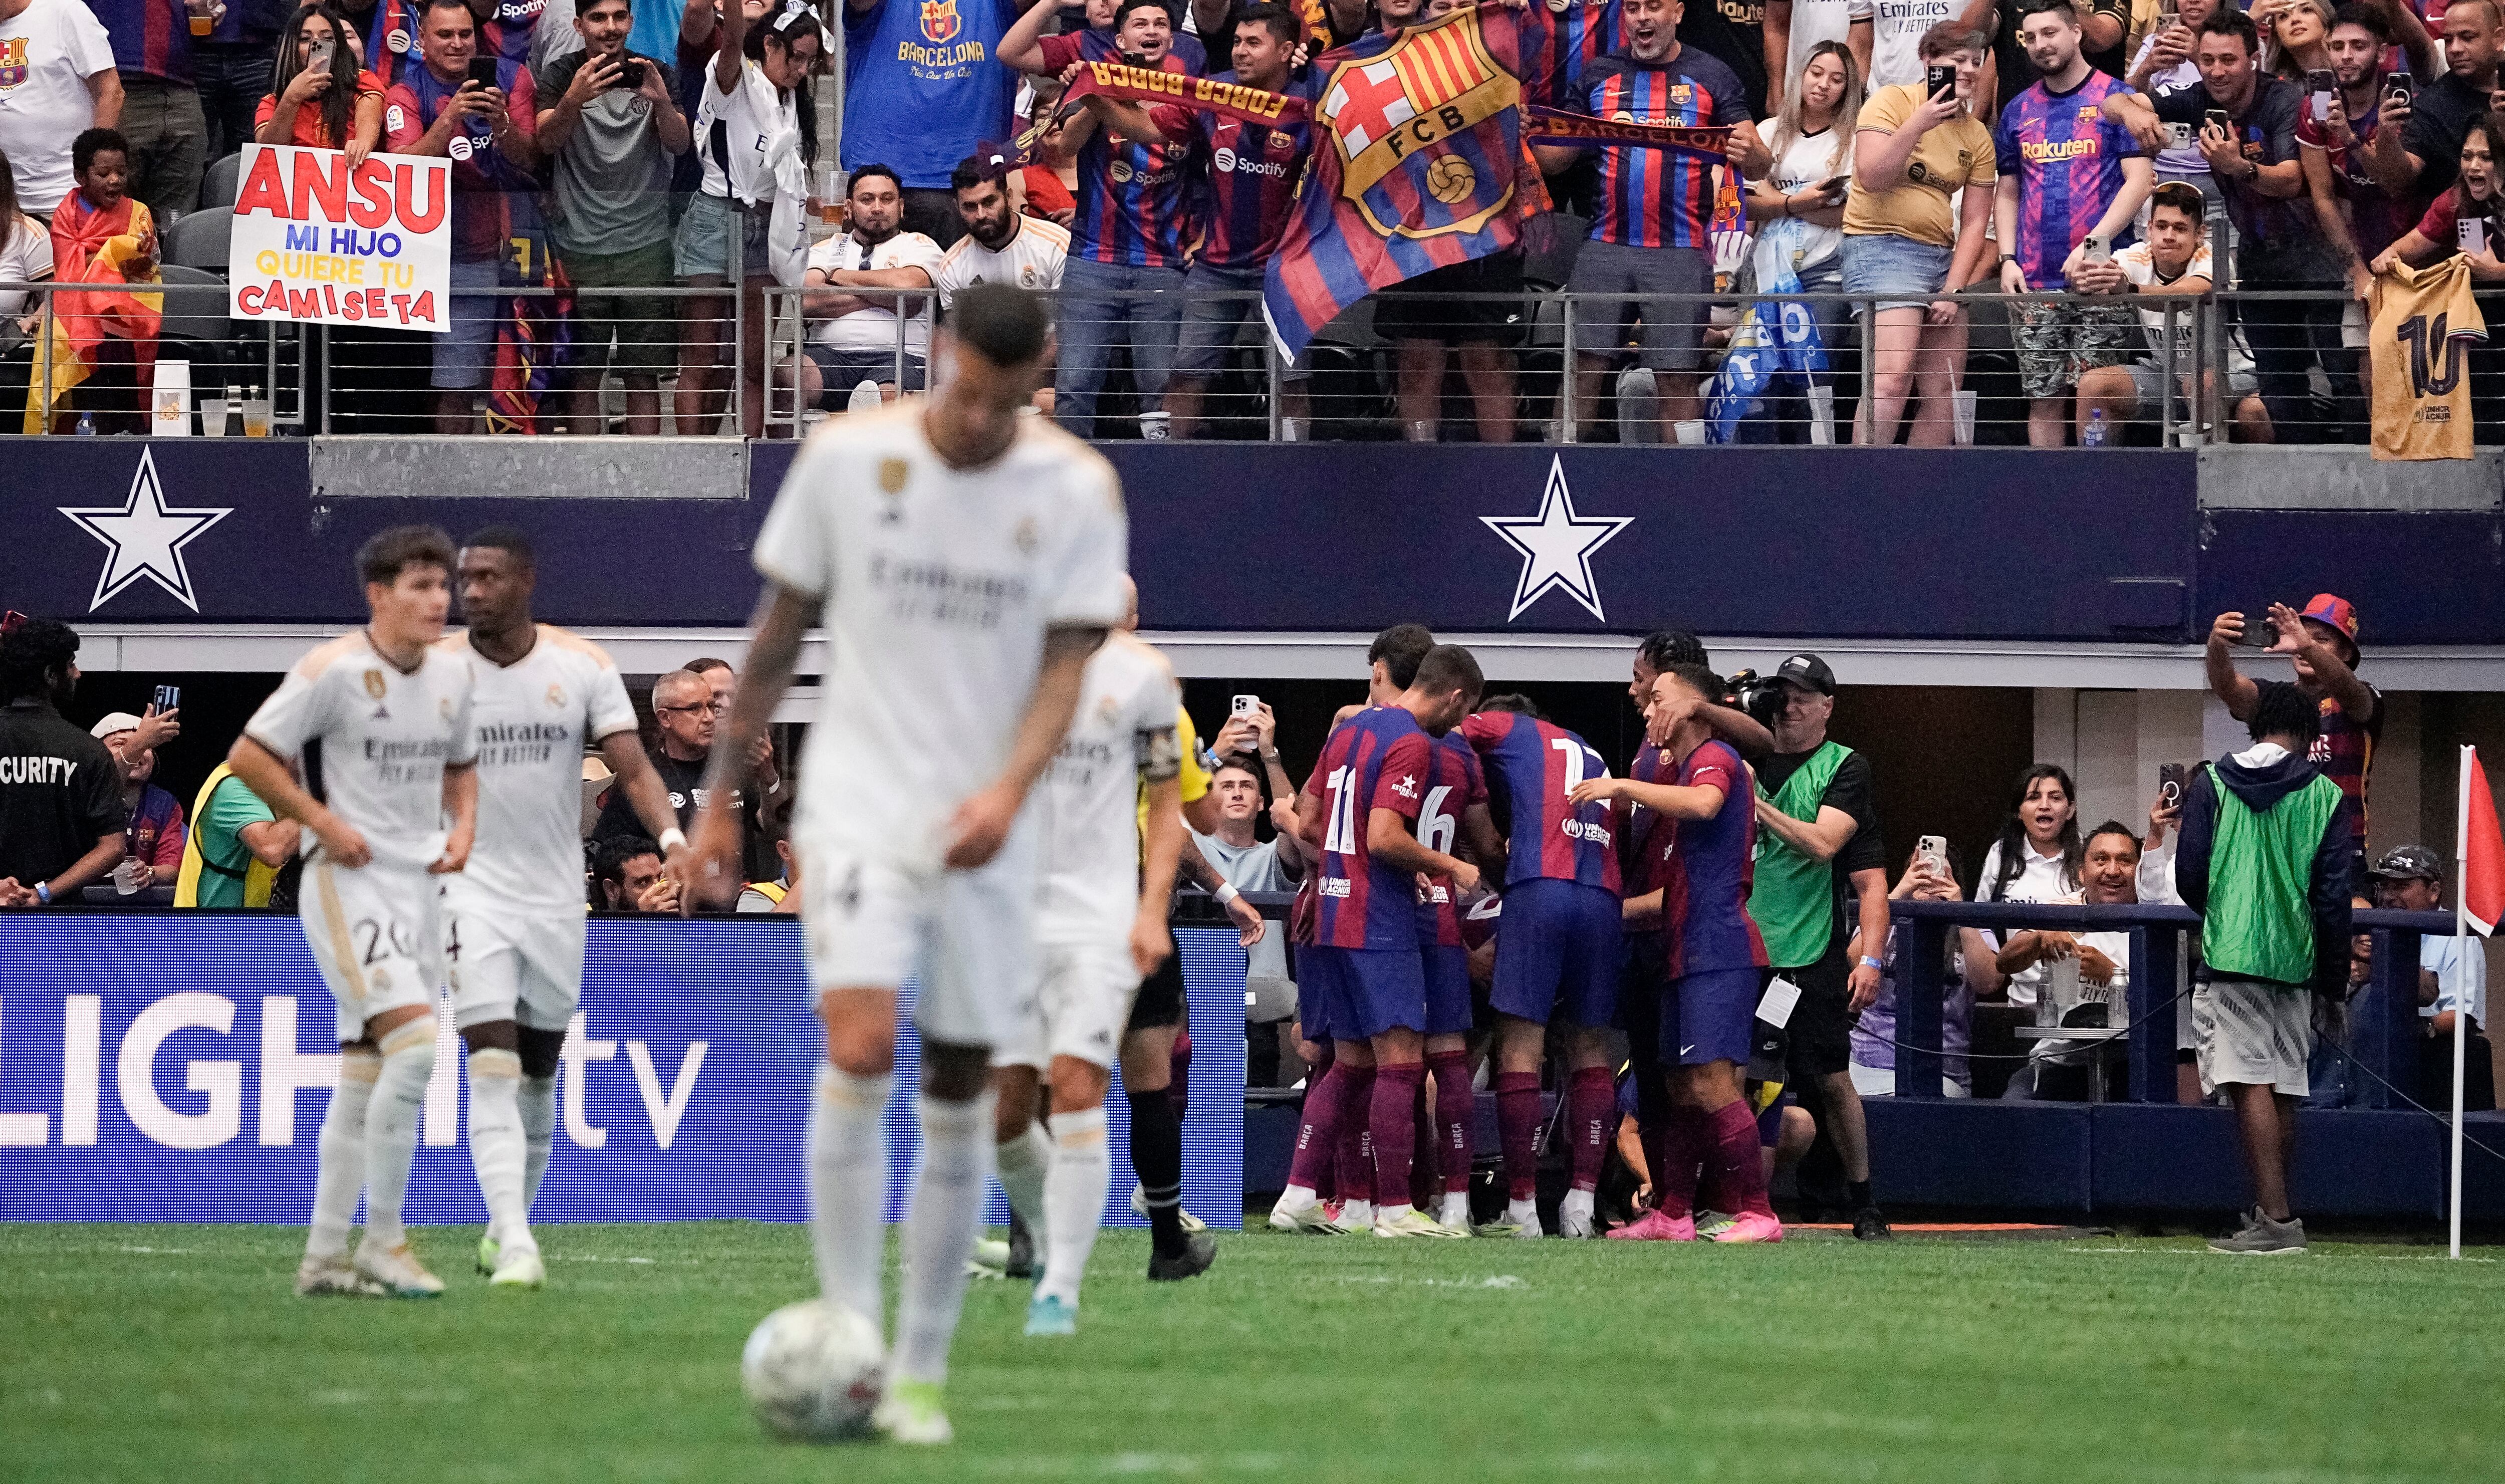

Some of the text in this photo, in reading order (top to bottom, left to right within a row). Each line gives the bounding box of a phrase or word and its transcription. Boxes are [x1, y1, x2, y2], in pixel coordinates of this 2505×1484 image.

[1880, 1, 1948, 18] Emirates
[898, 41, 985, 67] BARCELONA
[1549, 118, 1728, 152] BARCELON
[2021, 138, 2097, 160] Rakuten
[1238, 157, 1287, 177] Spotify
[234, 147, 445, 234] ANSU
[286, 224, 402, 258] MI HIJO
[256, 251, 414, 289] QUIERE TU
[238, 280, 435, 324] CAMISETA
[2397, 312, 2461, 399] 10
[477, 722, 569, 744] mirates
[1391, 783, 1418, 800] ESTRELLA
[1324, 765, 1356, 855] 11
[1417, 786, 1455, 855] 6
[1585, 822, 1611, 841] UNHCR
[1327, 885, 1351, 894] ACNUR
[1329, 877, 1351, 887] UNHCR
[1299, 1124, 1313, 1150] BARÇA
